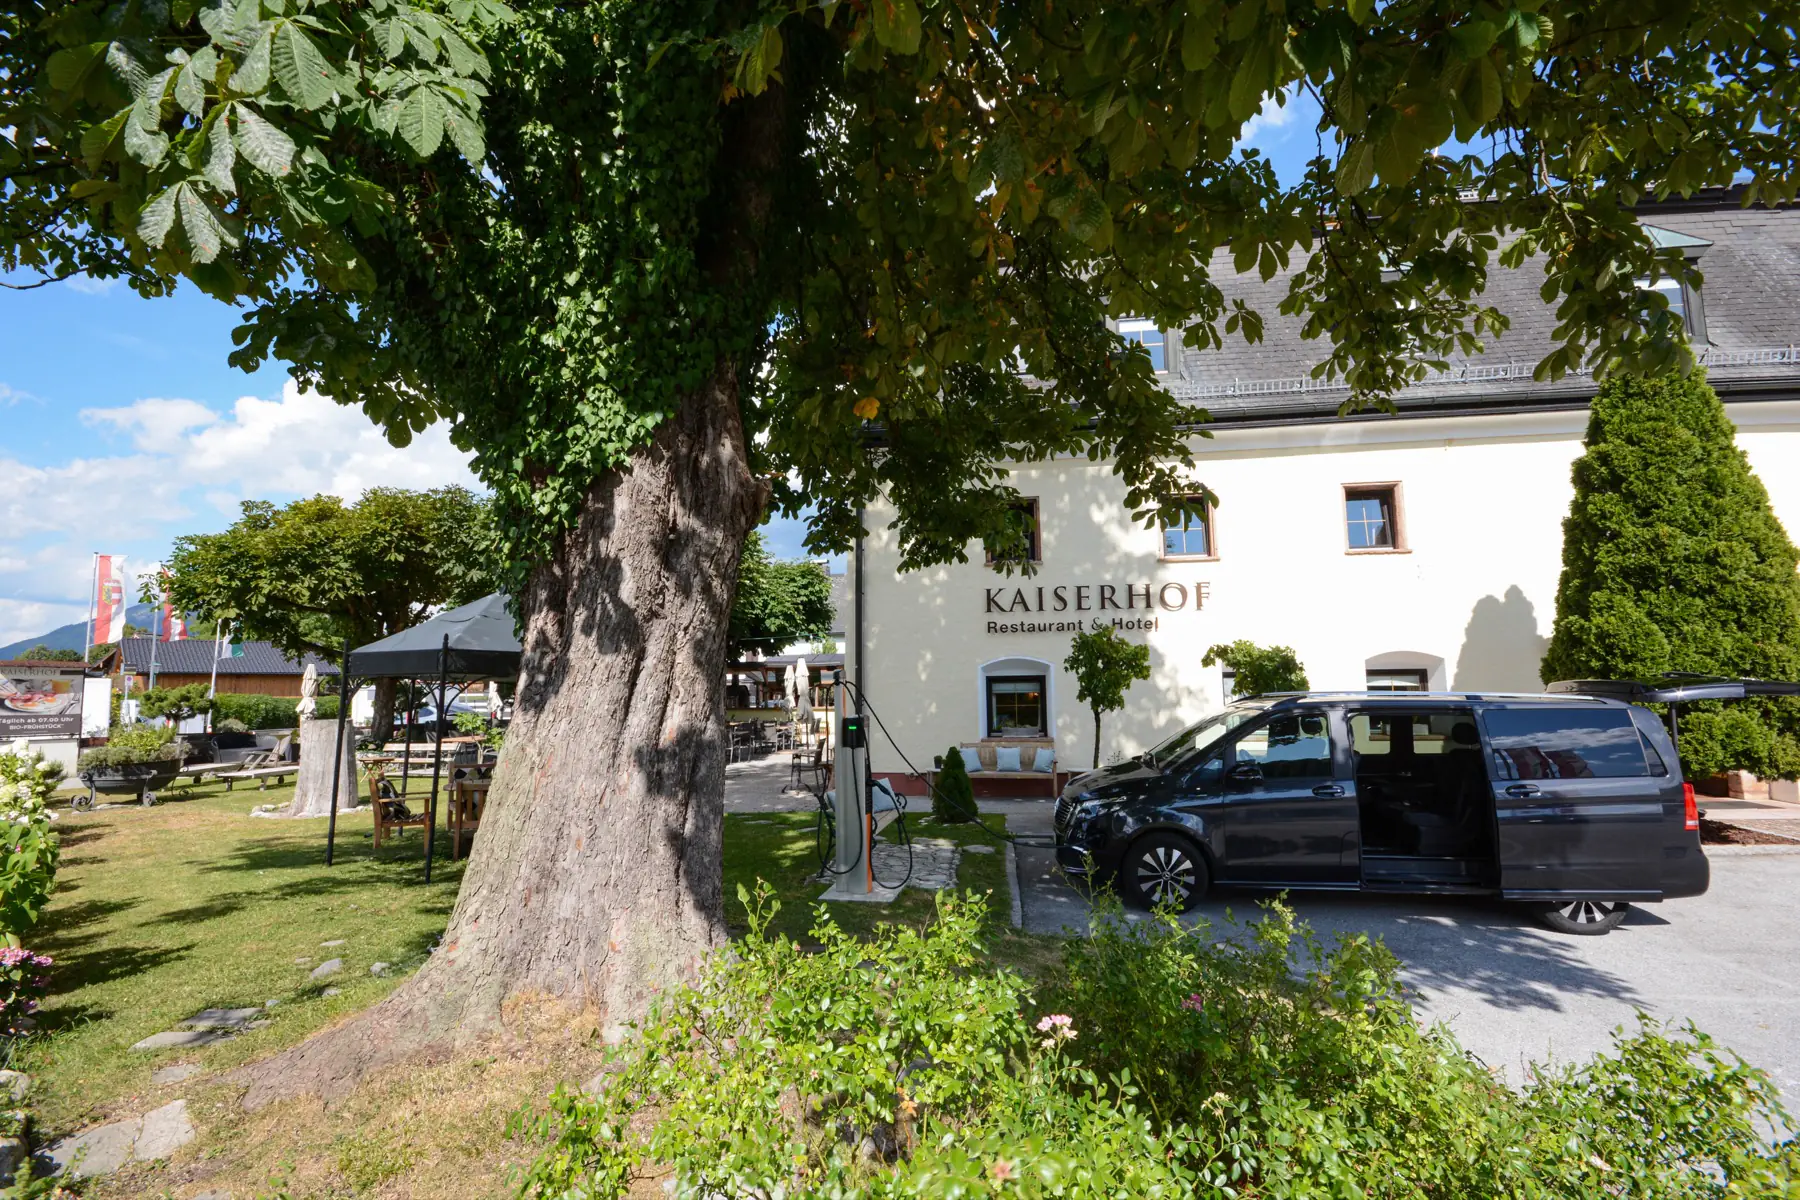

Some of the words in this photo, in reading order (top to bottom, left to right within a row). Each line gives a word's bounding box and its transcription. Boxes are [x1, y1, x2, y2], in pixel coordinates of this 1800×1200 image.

[984, 582, 1210, 613] KAISERHOF
[987, 619, 1083, 633] Restaurant
[1091, 616, 1102, 631] &
[1112, 617, 1158, 632] Hotel
